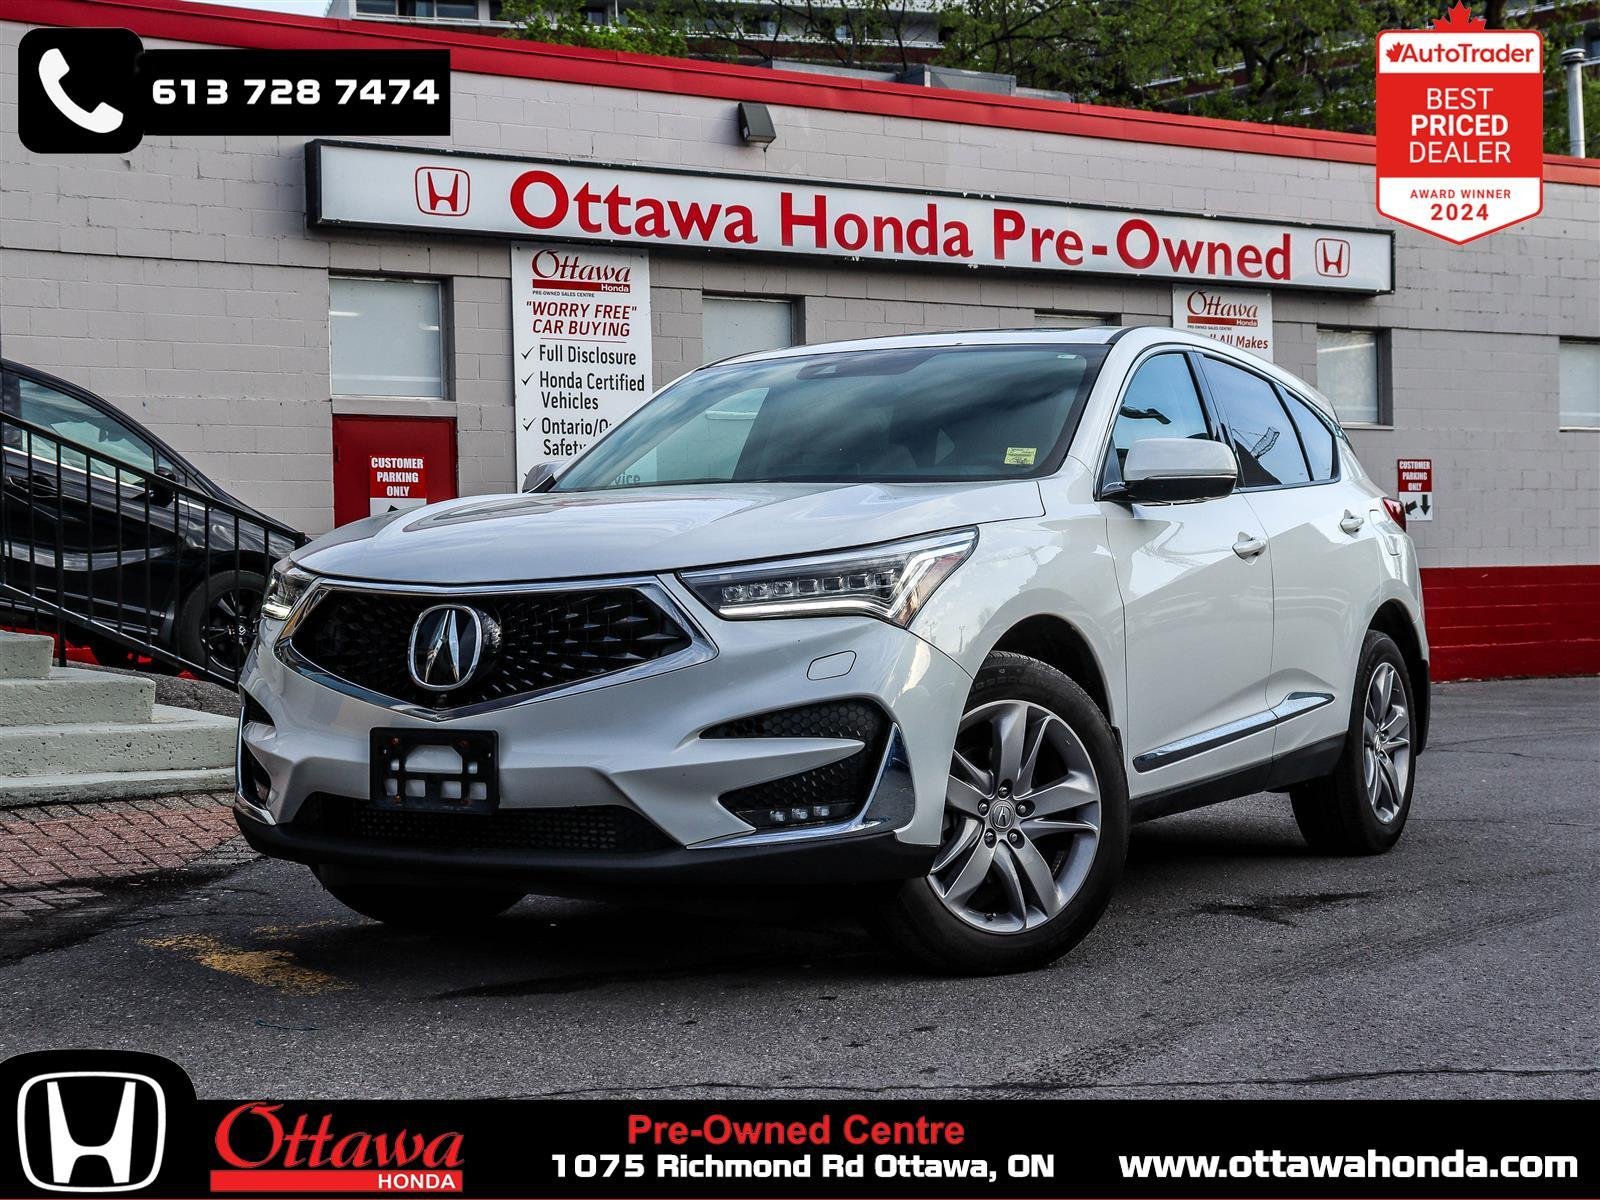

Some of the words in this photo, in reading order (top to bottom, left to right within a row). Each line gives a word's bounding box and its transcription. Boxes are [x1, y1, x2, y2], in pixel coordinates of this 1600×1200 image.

[510, 170, 758, 245] Ottawa
[780, 192, 973, 257] Honda
[993, 208, 1292, 281] Pre-Owned
[531, 249, 631, 282] Ottawa
[601, 283, 629, 293] Honda
[526, 301, 590, 318] "WORRY
[595, 304, 637, 320] FREE"
[1187, 289, 1258, 318] Ottawa
[532, 319, 563, 335] CAR
[568, 321, 630, 337] BUYING
[1236, 319, 1258, 327] Honda
[1236, 336, 1268, 350] Makes
[539, 344, 563, 363] Full
[568, 346, 637, 366] Disclosure
[539, 371, 583, 389] Honda
[587, 373, 645, 392] Certified
[541, 391, 599, 410] Vehicles
[371, 457, 424, 469] CUSTOMER
[1399, 461, 1431, 470] CUSTOMER
[376, 471, 419, 483] PARKING
[1402, 471, 1428, 480] PARKING
[386, 485, 410, 497] ONLY
[1407, 482, 1423, 491] ONLY
